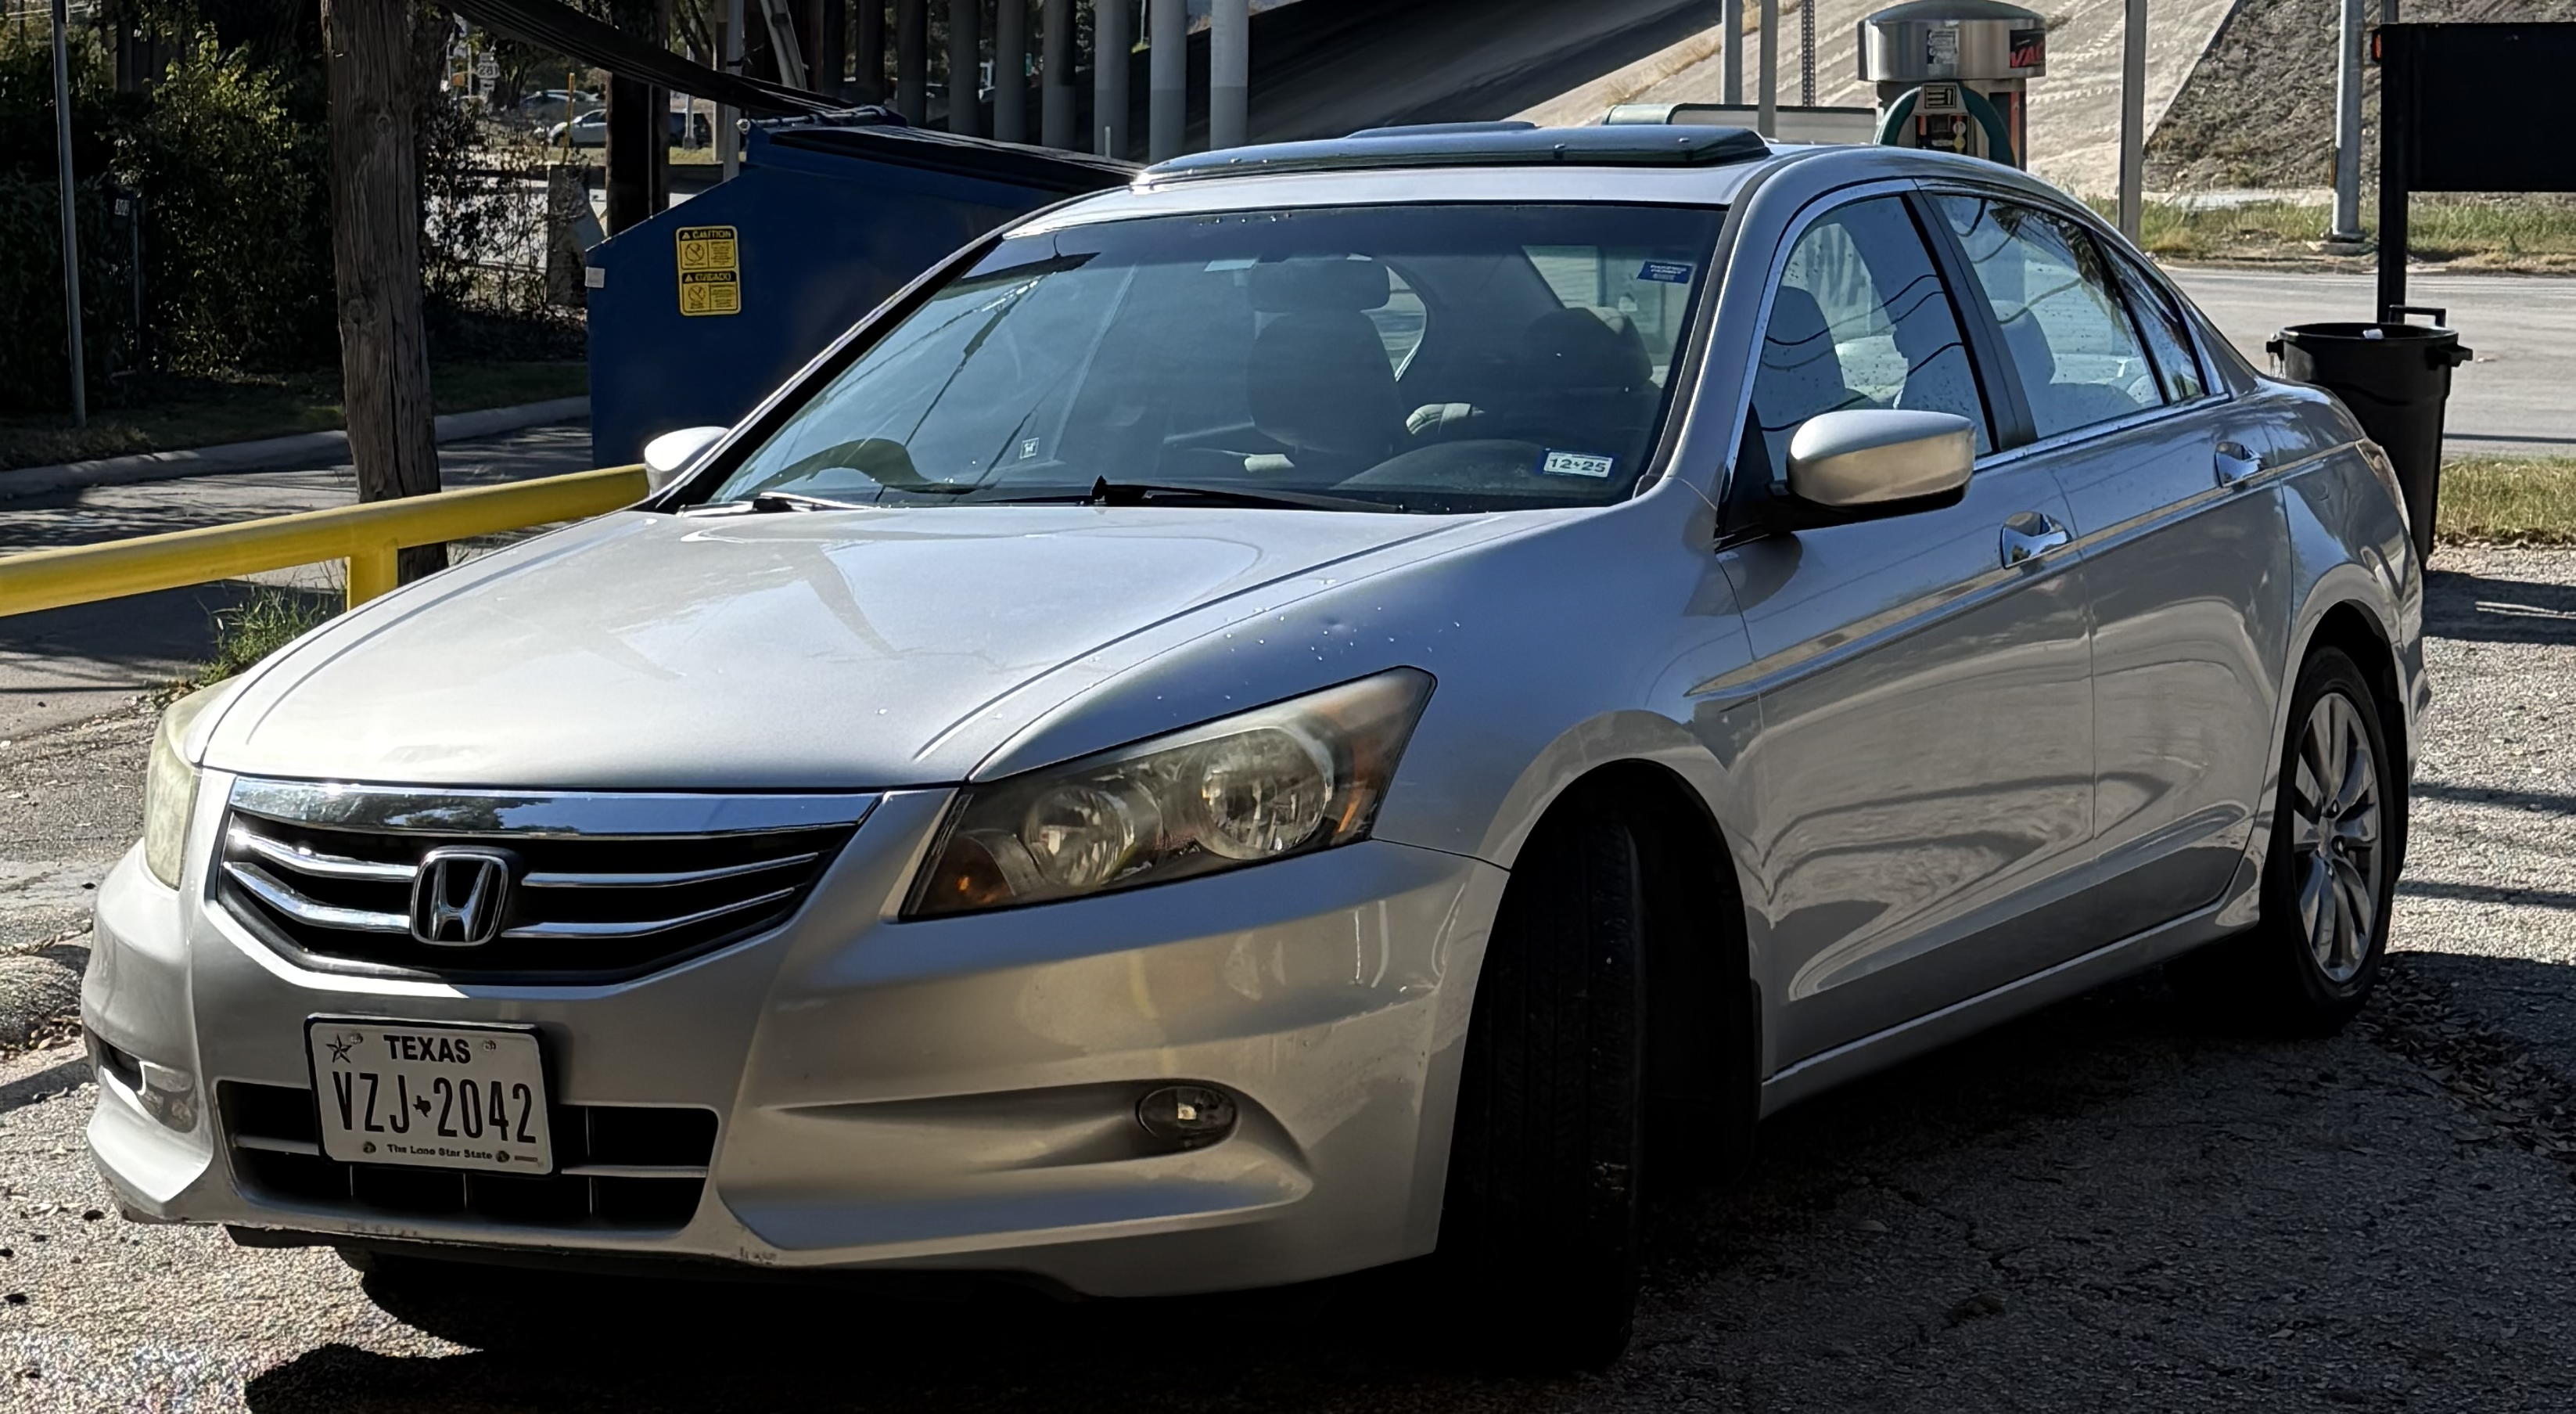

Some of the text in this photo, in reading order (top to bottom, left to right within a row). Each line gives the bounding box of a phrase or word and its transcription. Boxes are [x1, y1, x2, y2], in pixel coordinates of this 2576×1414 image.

[692, 230, 731, 239] CAUTION
[383, 1034, 471, 1064] TEXAS
[386, 1143, 493, 1160] The Lone Star State
